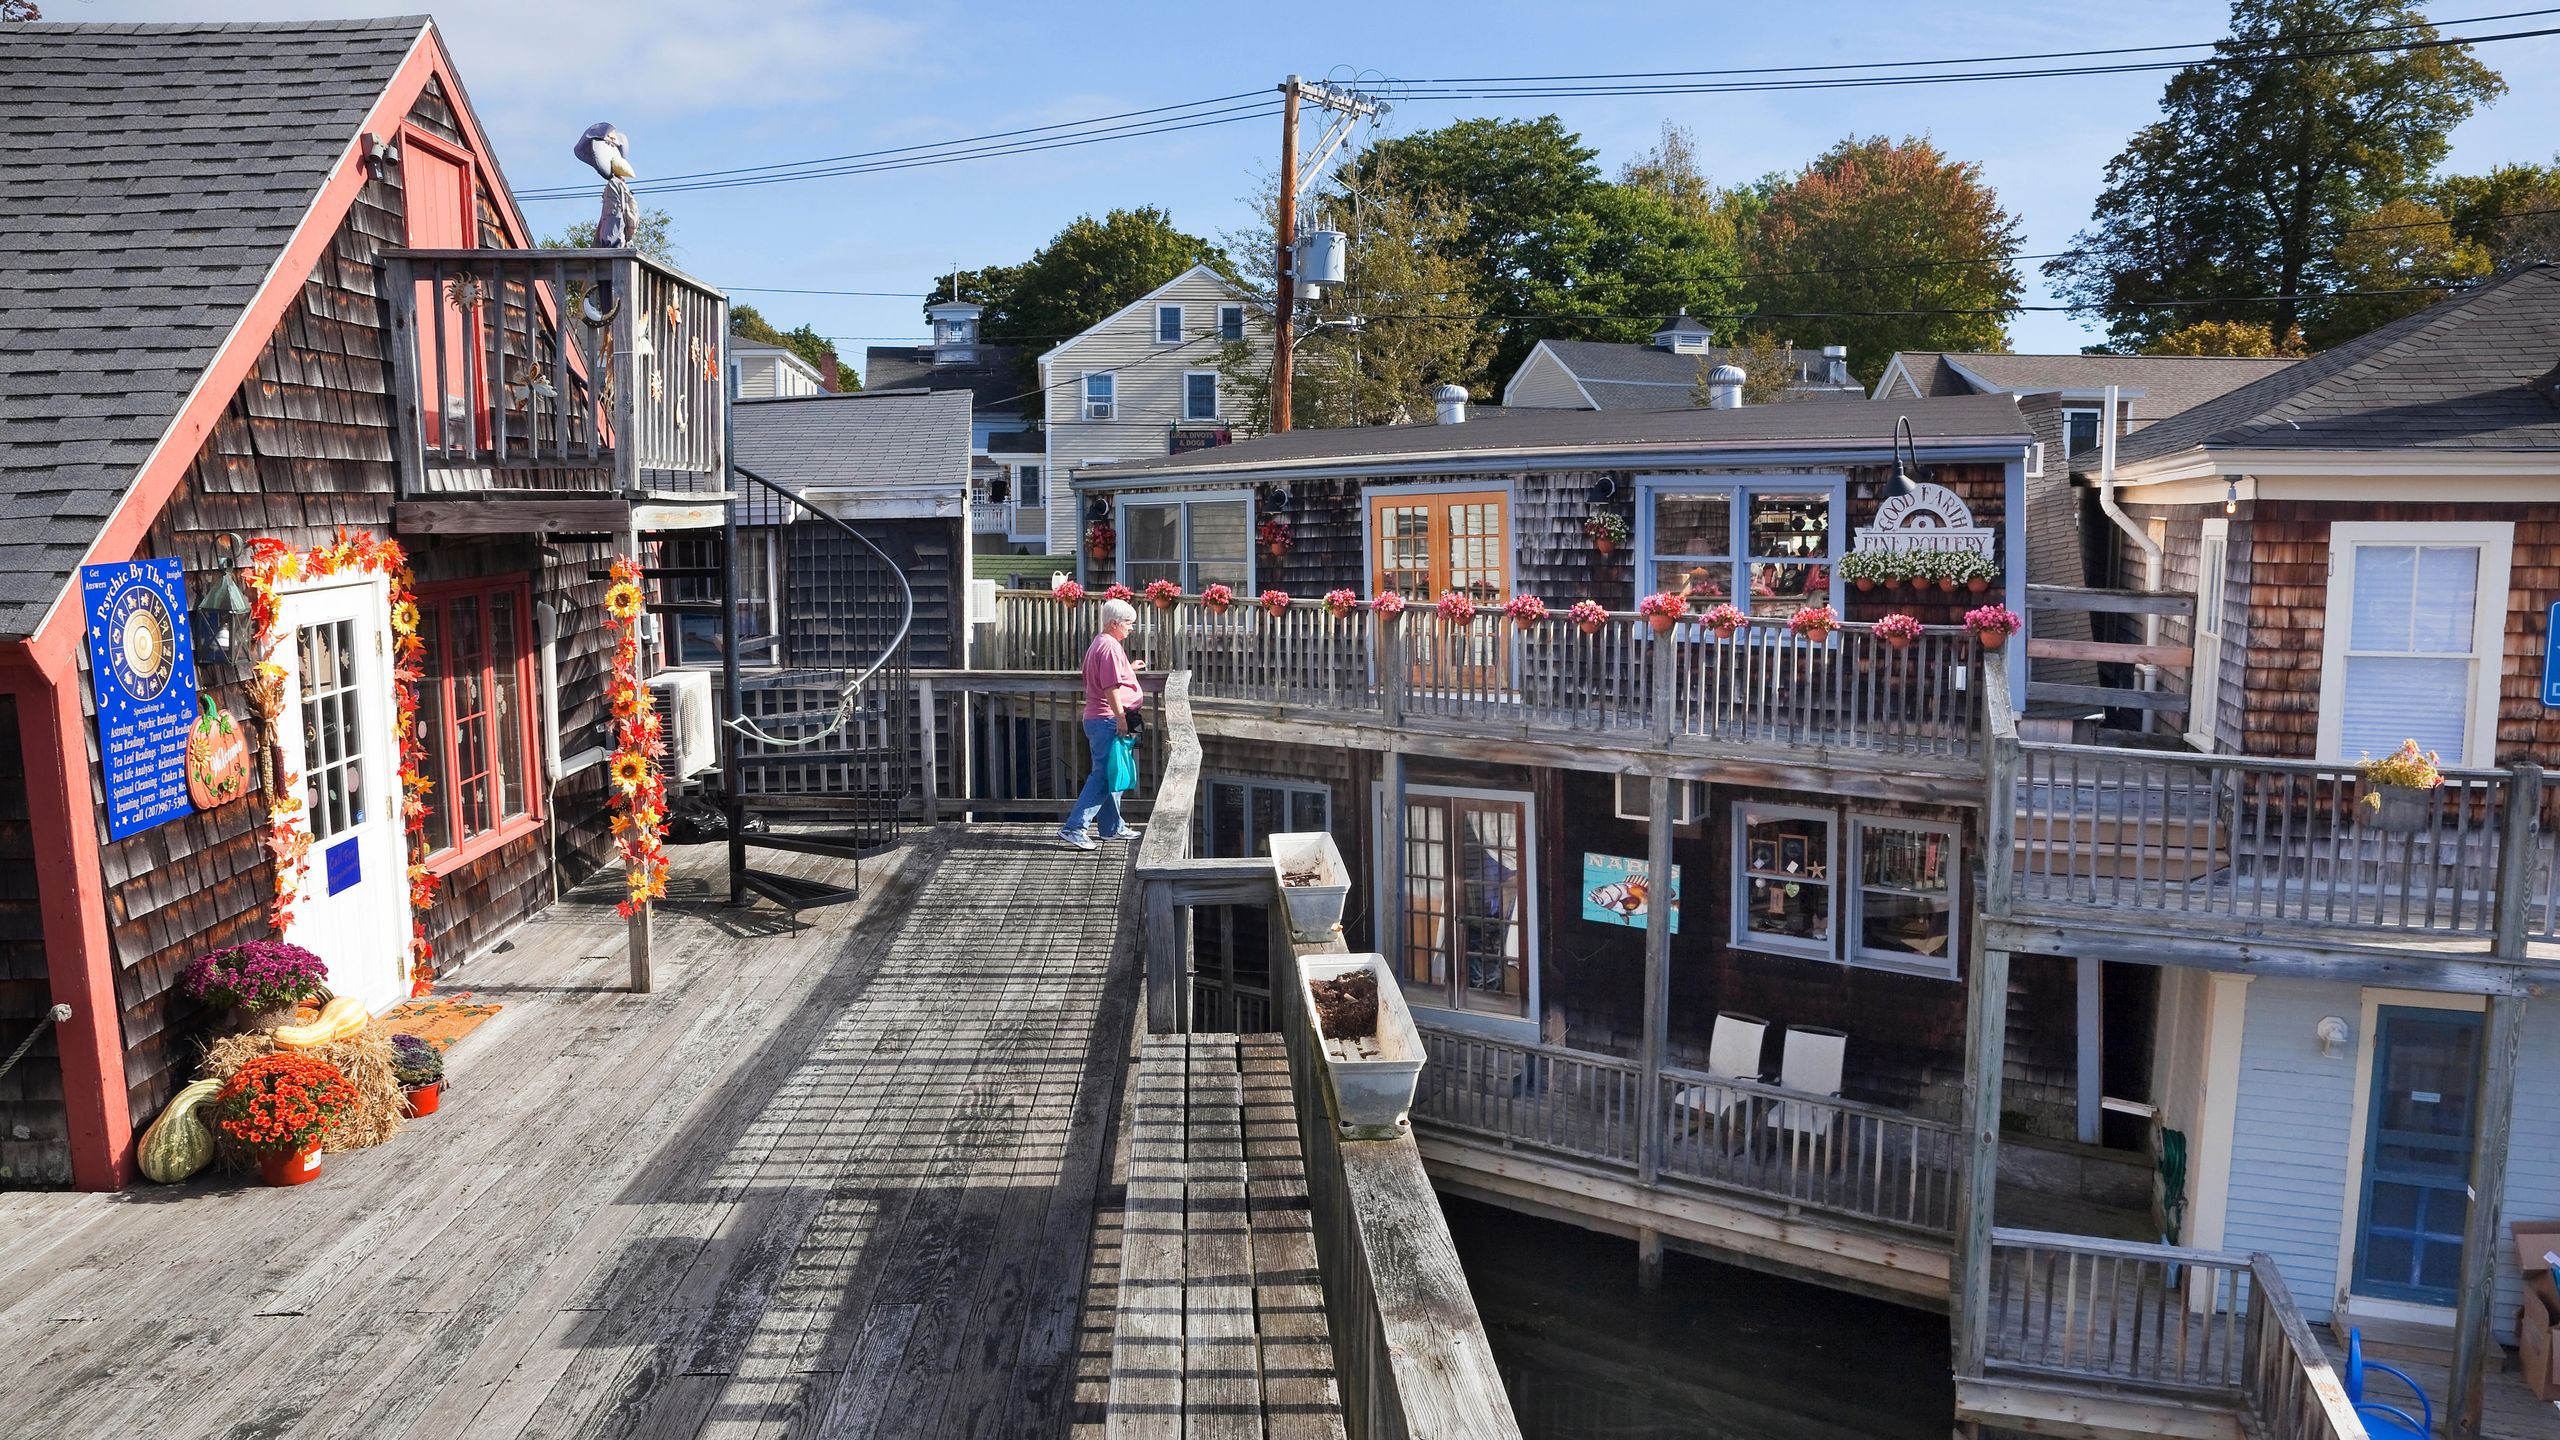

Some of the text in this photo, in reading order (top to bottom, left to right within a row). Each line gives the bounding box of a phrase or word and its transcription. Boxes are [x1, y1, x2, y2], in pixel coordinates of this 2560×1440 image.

[1879, 485, 1967, 532] GOOD EARTH
[1864, 536, 1987, 552] FINE POTTERY
[90, 569, 100, 578] Get
[166, 571, 182, 580] Insight
[170, 560, 178, 568] Get
[85, 582, 107, 590] Answers
[97, 564, 179, 621] Psychic By The Sea
[134, 704, 160, 717] Specializing
[111, 708, 193, 738] Astrology Psychic Readings Gifts
[111, 741, 123, 754] Palm
[124, 736, 146, 750] Readings
[150, 732, 162, 743] Tarot
[163, 726, 174, 739] Card
[114, 757, 122, 768] Tea
[124, 751, 134, 765] Leaf
[136, 748, 156, 761] Readings
[161, 744, 175, 754] Dream
[210, 740, 243, 778] Welcome
[113, 773, 123, 784] Past
[125, 767, 134, 780] Life
[135, 762, 154, 777] Analysis
[114, 782, 134, 802] Spiritual
[135, 777, 157, 792] Cleansing
[162, 770, 178, 783] Chakra
[117, 798, 139, 813] Reuniting
[140, 793, 155, 805] Lovers
[160, 785, 177, 799] Healing
[132, 809, 143, 823] call
[1588, 855, 1679, 879] NABS
